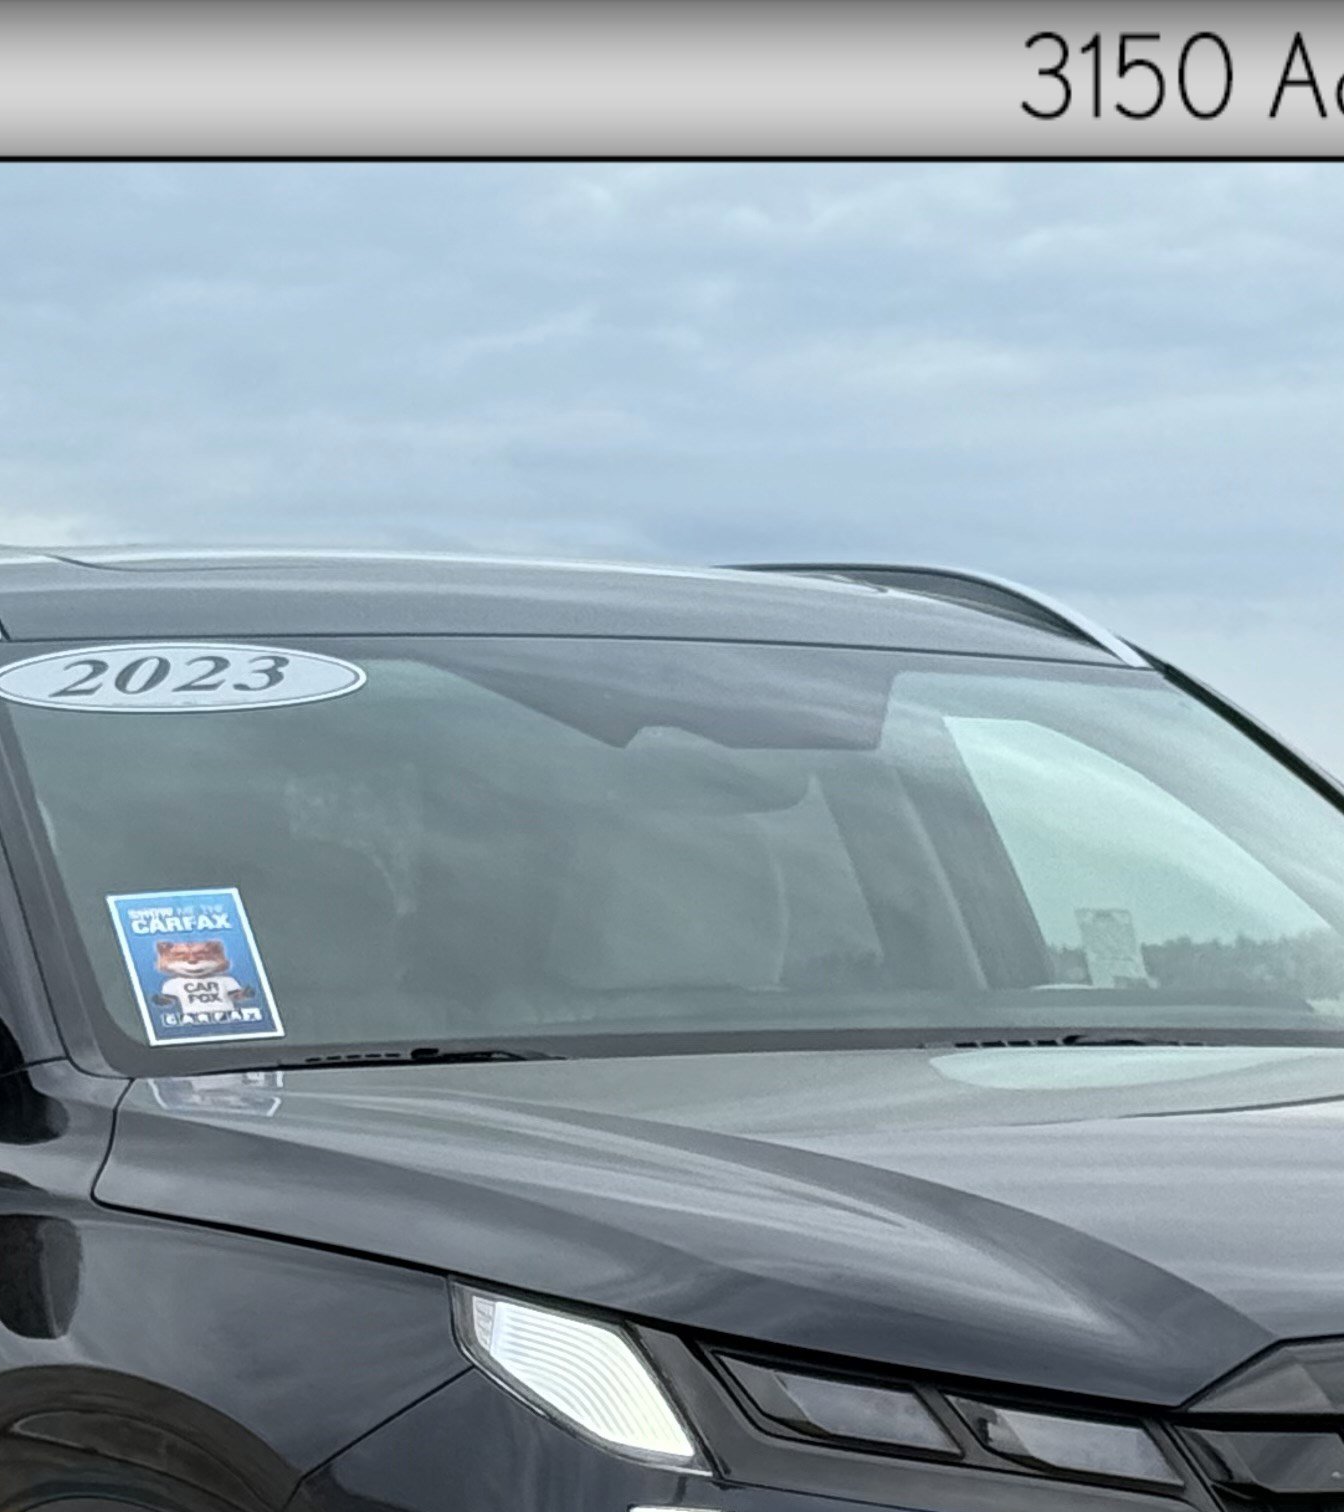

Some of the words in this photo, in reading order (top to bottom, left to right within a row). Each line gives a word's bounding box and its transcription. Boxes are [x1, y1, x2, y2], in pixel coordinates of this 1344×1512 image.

[49, 655, 290, 698] 2023
[131, 912, 233, 935] CARFAX
[183, 981, 219, 993] CAR
[188, 993, 223, 1004] FOX
